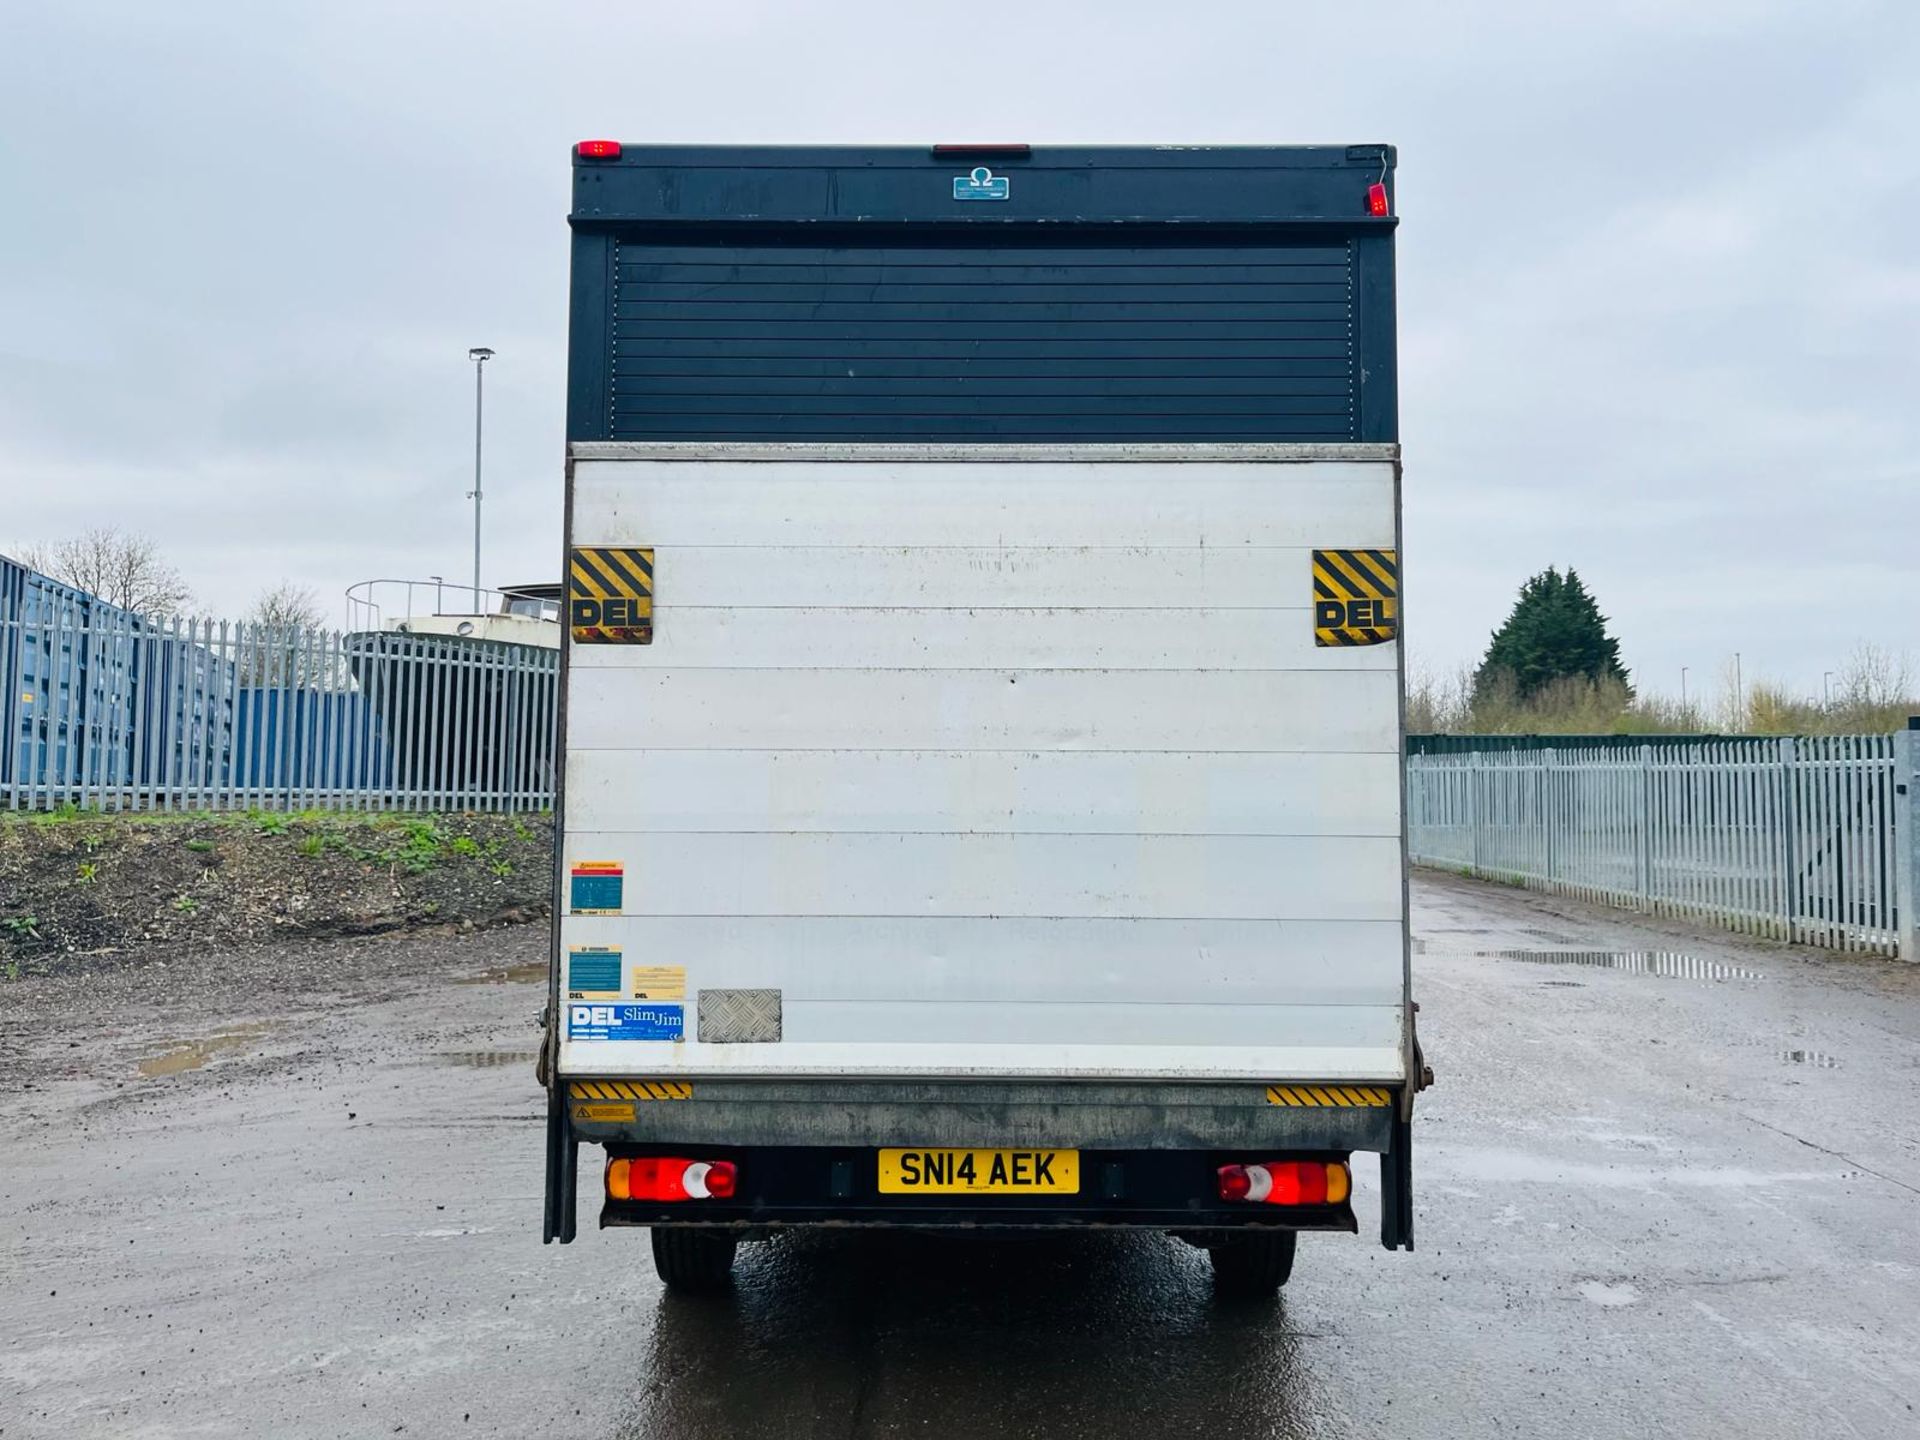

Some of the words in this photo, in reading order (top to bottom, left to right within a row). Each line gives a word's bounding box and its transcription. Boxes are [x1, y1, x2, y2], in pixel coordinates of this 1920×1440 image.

[572, 599, 651, 626] DEL
[1316, 600, 1396, 627] DEL
[572, 1007, 622, 1026] DEL
[623, 1007, 655, 1021] Slim
[655, 1012, 682, 1026] Jim
[900, 1153, 977, 1185] SN14
[988, 1153, 1056, 1185] AEK
